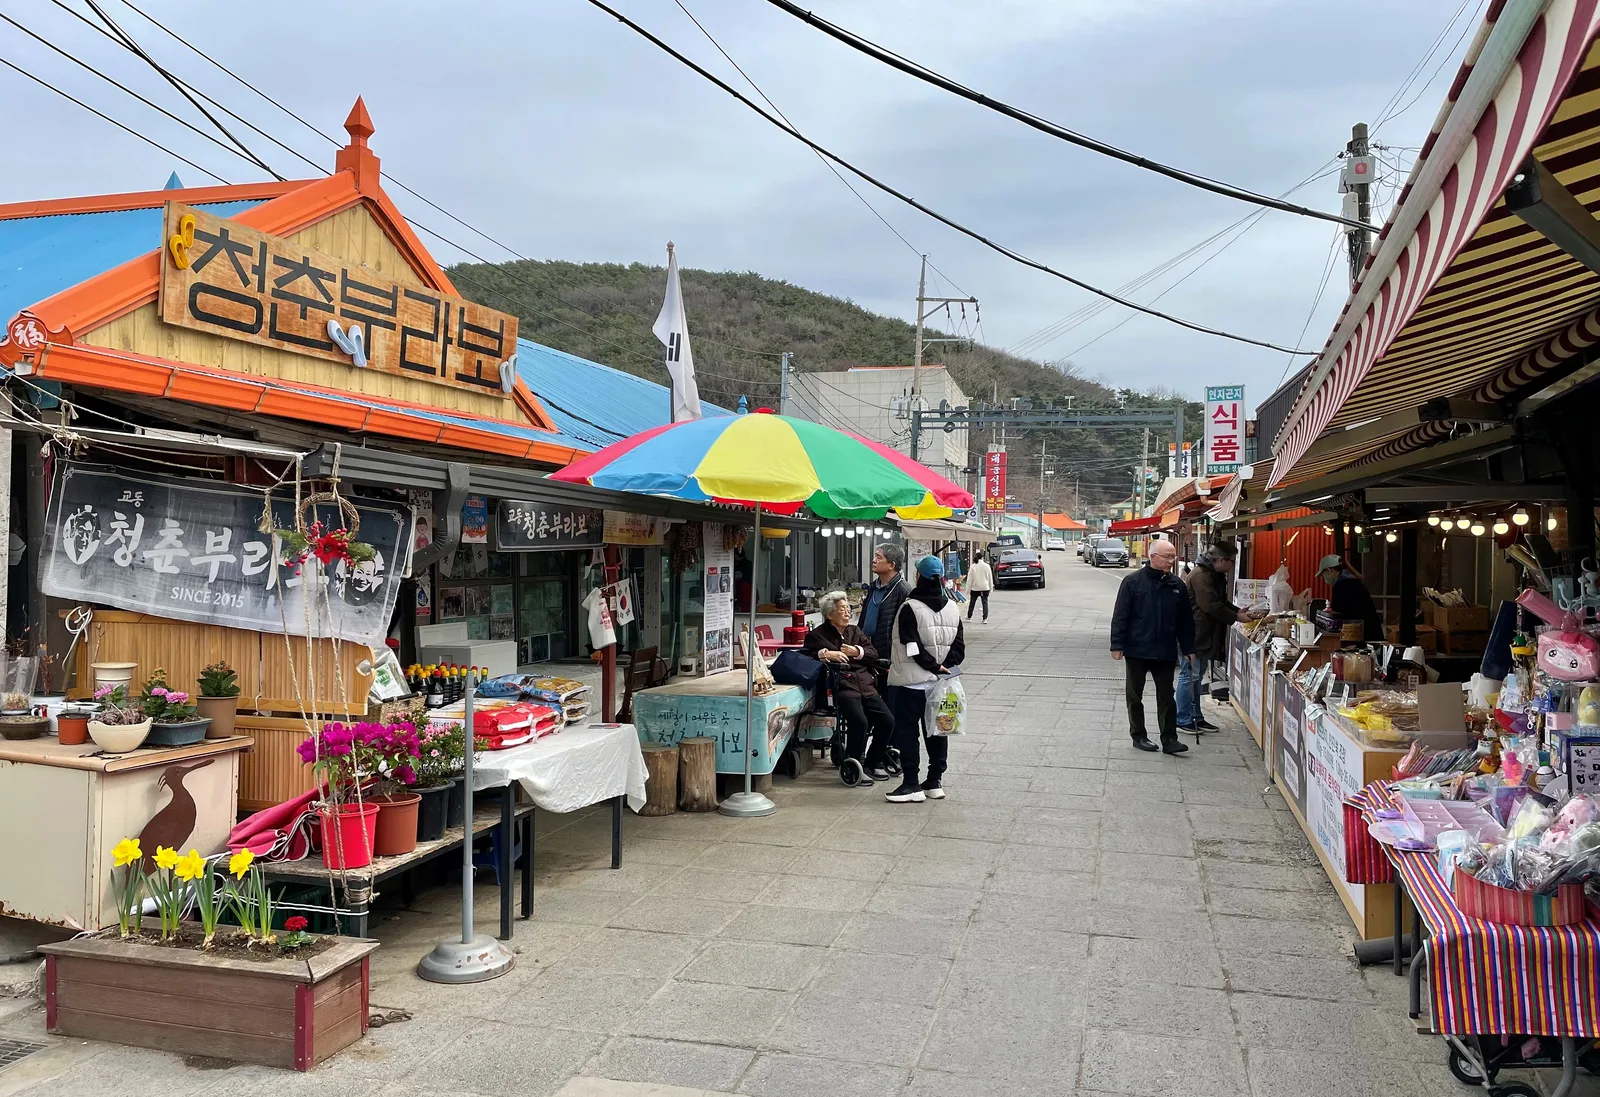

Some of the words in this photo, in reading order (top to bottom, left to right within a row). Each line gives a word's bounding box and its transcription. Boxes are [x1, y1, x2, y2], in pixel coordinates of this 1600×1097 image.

[188, 227, 503, 390] 청춘부라보
[1208, 387, 1242, 400] 연지곤지
[1211, 403, 1240, 461] 식품
[117, 489, 145, 508] 교동
[507, 508, 523, 525] 교동
[523, 511, 588, 540] 청춘부라보
[171, 586, 211, 603] SINCE
[214, 592, 245, 609] 2015
[721, 712, 731, 726] 곳
